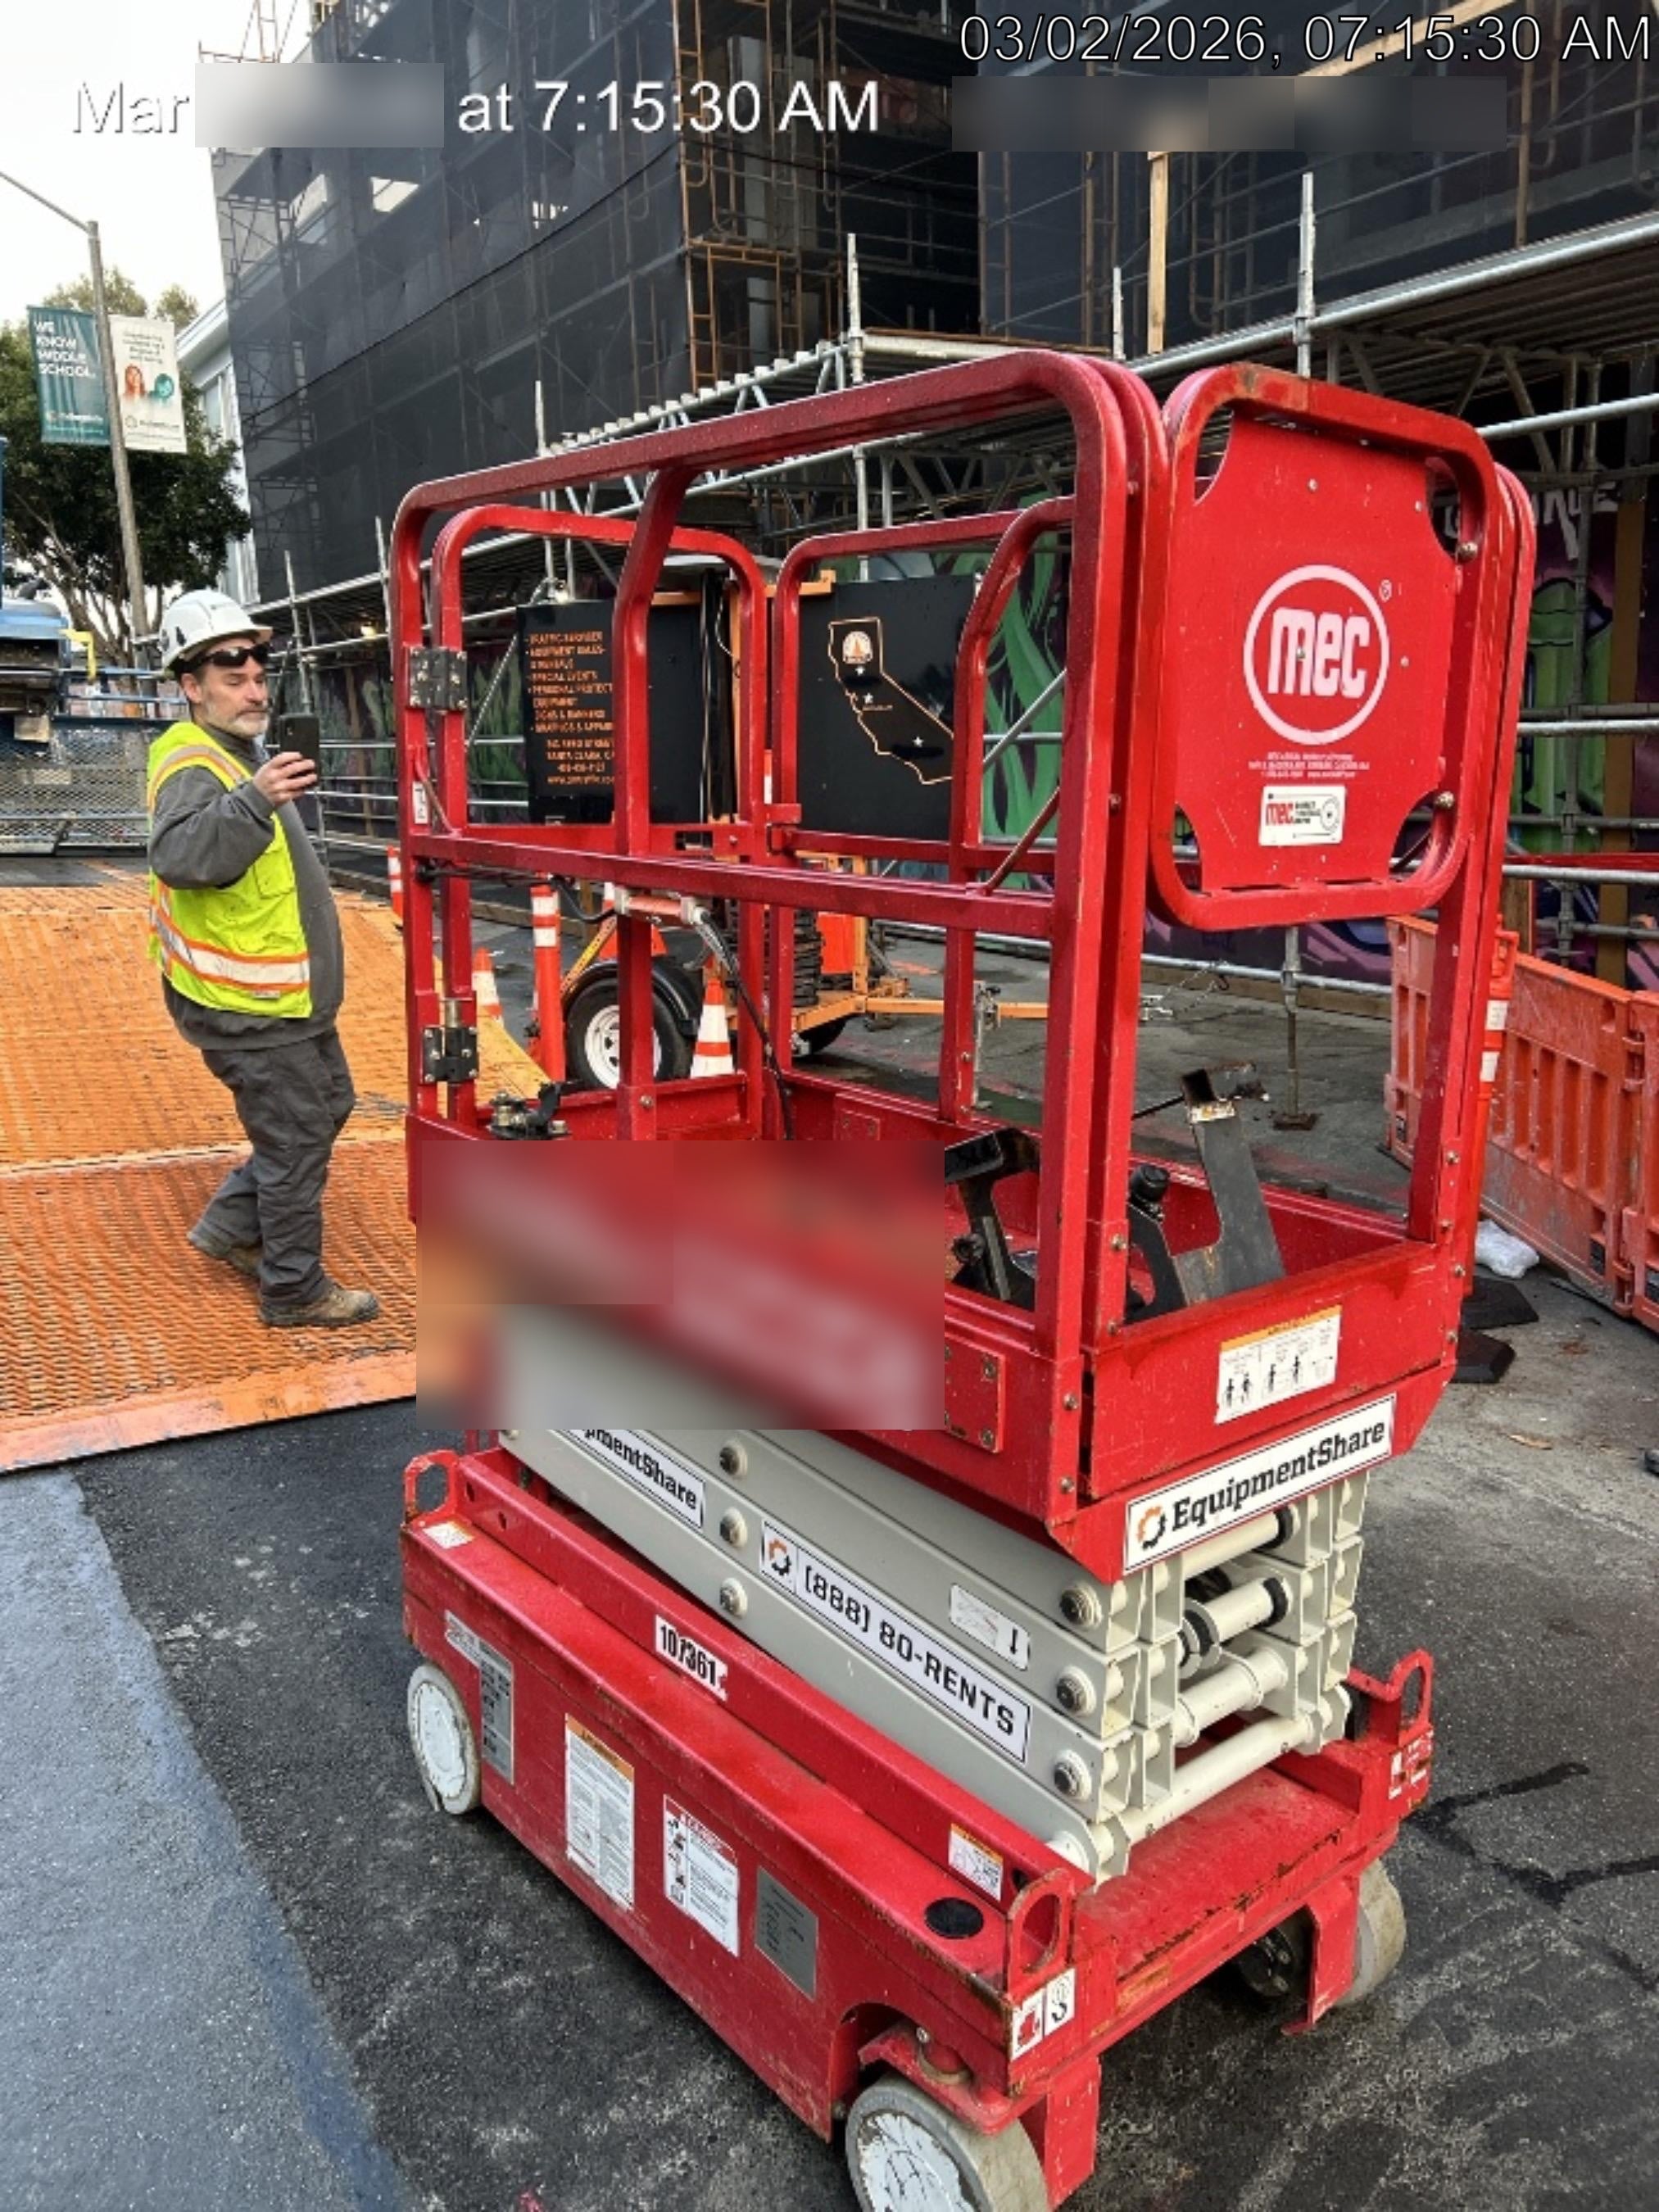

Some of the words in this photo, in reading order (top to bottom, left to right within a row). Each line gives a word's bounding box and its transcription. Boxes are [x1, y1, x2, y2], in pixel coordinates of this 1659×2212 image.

[1172, 1420, 1385, 1531] EquipmentShare
[805, 1565, 871, 1633] (888)
[879, 1621, 1014, 1736] 80-RENTS
